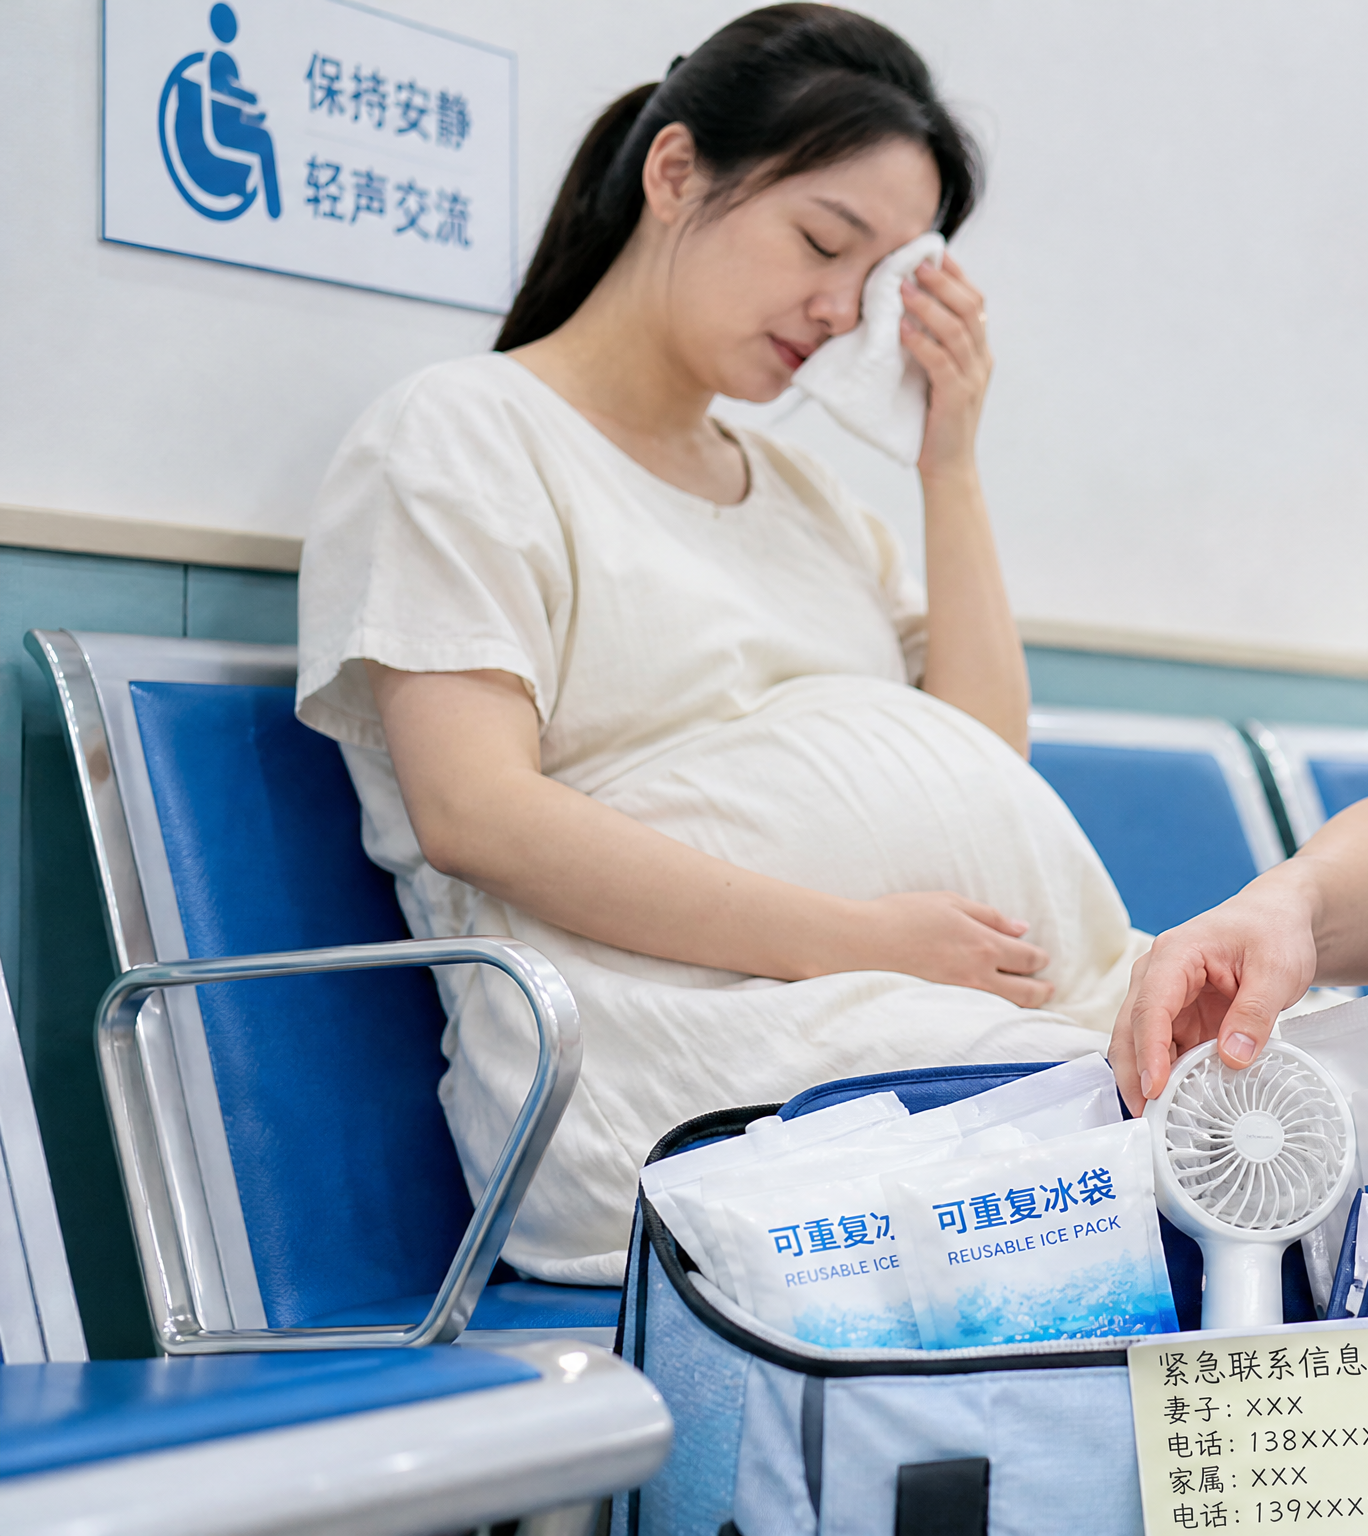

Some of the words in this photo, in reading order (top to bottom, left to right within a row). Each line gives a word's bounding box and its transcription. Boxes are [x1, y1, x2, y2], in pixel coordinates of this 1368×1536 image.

[303, 51, 472, 150] 保持安静
[303, 153, 473, 249] 轻声交流
[932, 1166, 1117, 1235] 可重复冰袋
[947, 1236, 1036, 1265] REUSABLE
[1040, 1228, 1069, 1247] ICE
[1073, 1215, 1122, 1239] PACK
[785, 1260, 870, 1288] REUSABLE
[873, 1254, 900, 1271] ICE
[1158, 1343, 1368, 1387] 紧急联系信息
